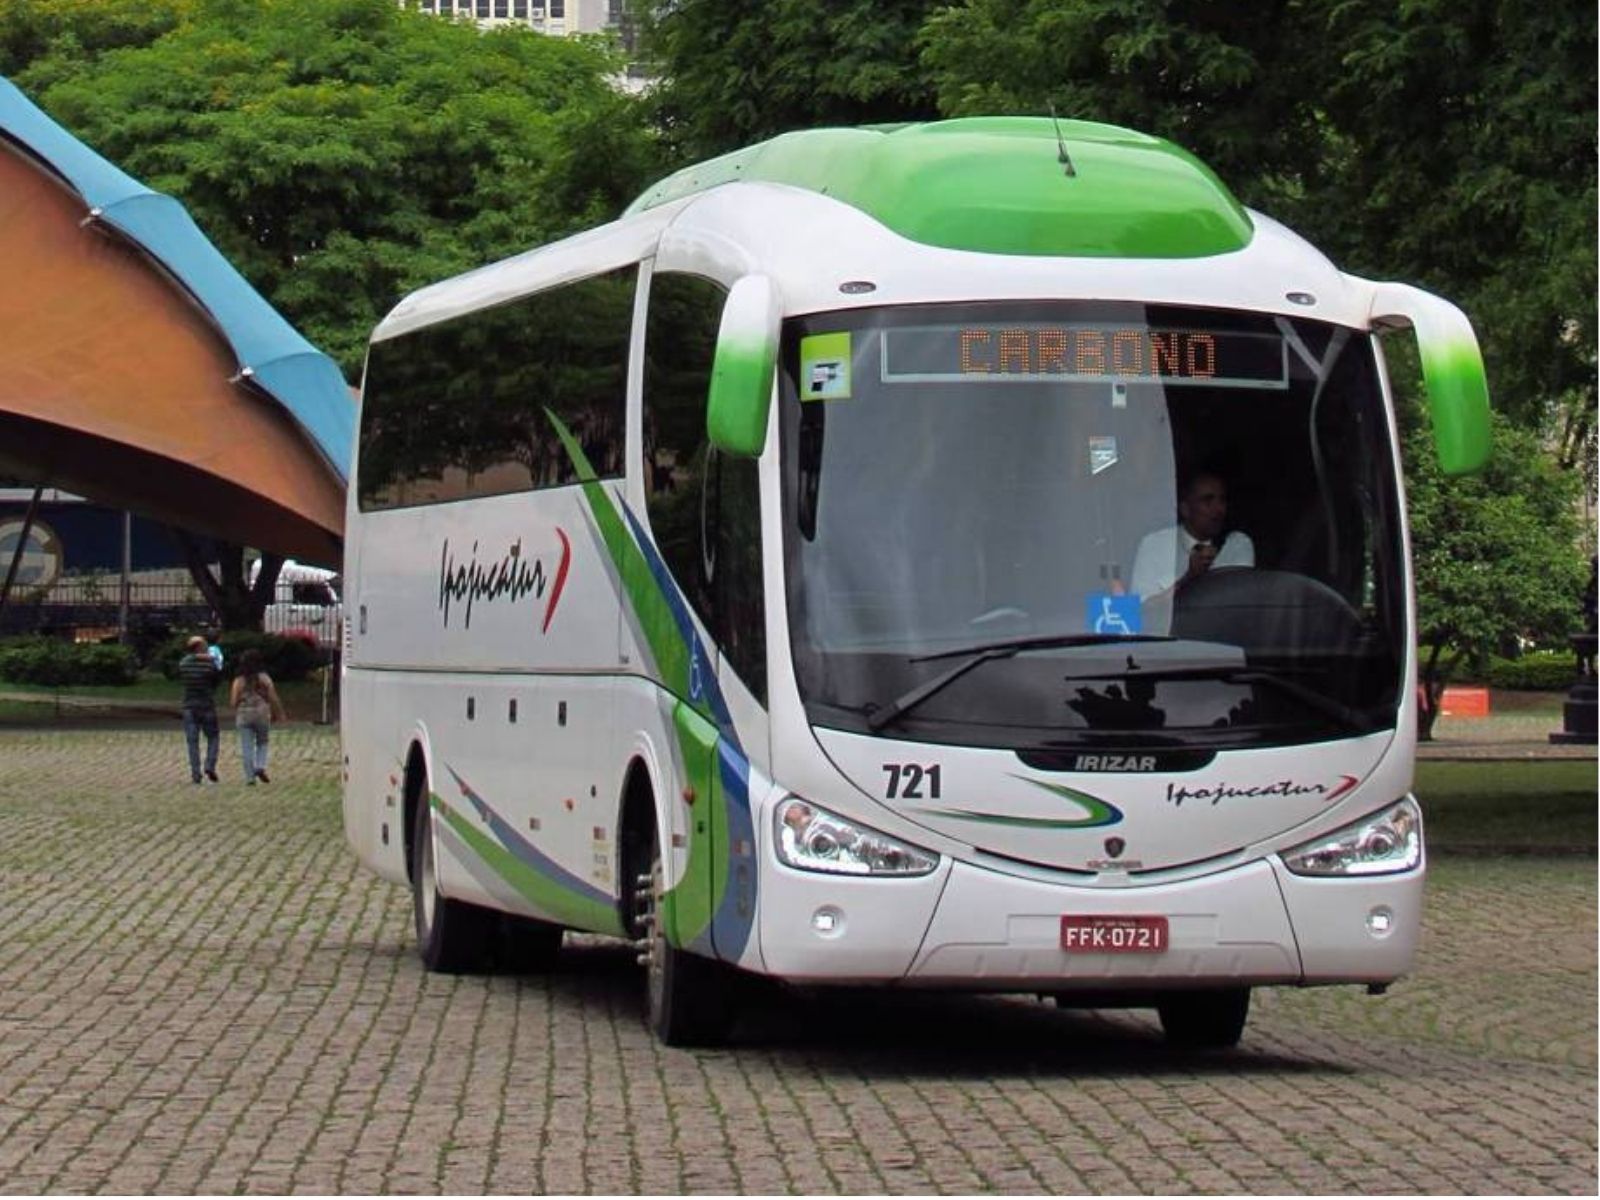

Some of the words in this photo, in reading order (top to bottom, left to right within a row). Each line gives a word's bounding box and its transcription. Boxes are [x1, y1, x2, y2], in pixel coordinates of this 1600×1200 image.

[960, 328, 1216, 379] CARBONO
[1075, 755, 1157, 771] IRIZAR
[882, 764, 941, 799] 721
[1166, 780, 1329, 806] Ipojucatur
